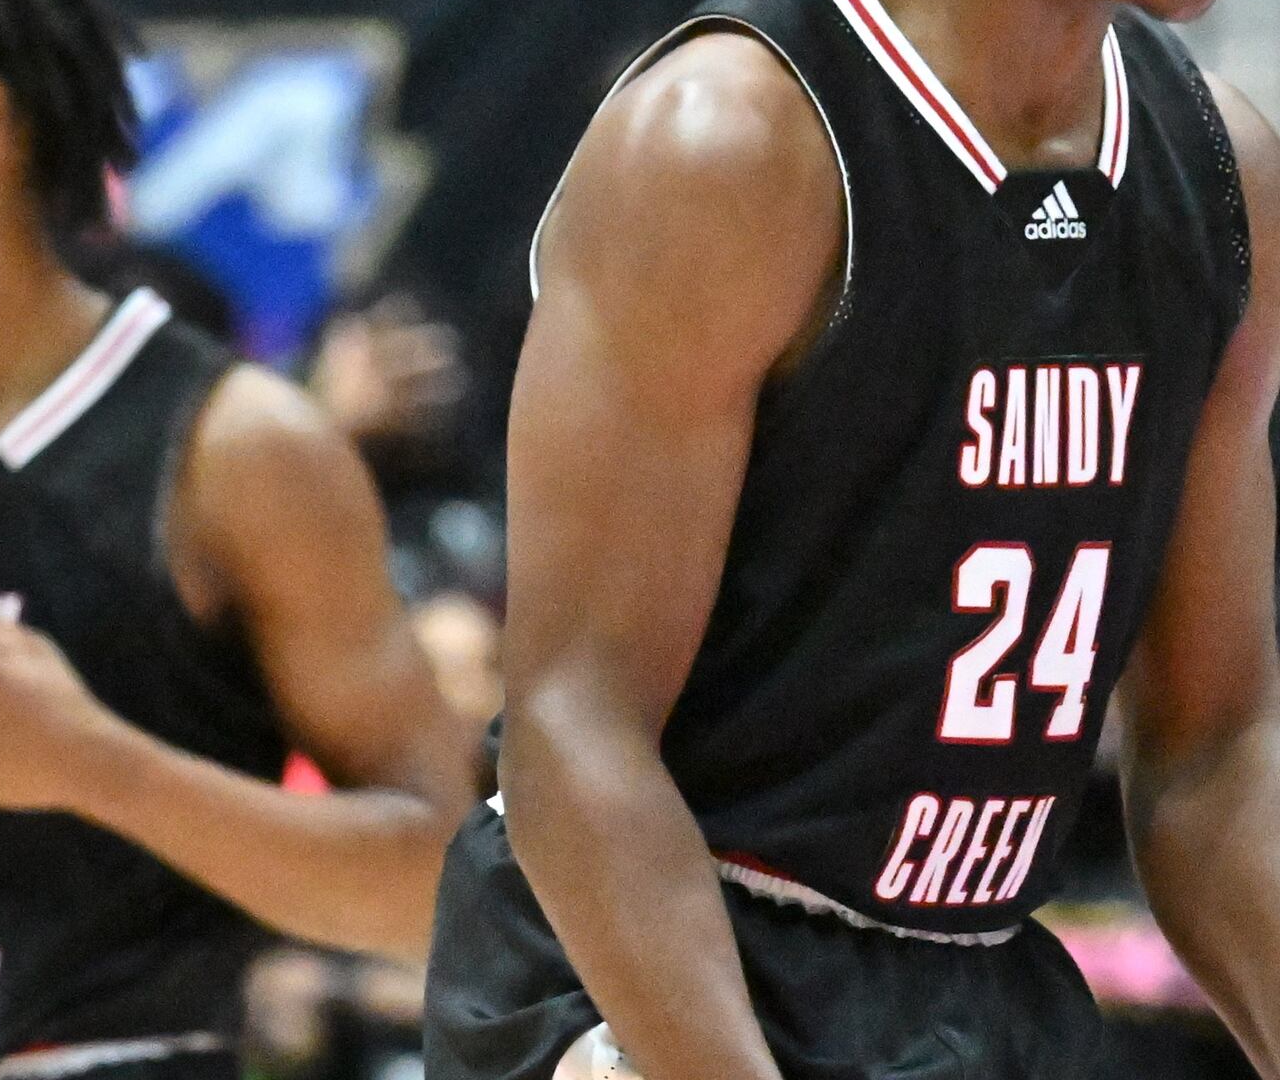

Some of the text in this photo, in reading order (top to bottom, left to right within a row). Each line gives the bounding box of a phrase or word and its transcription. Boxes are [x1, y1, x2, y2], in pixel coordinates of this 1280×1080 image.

[1024, 218, 1087, 240] adidas
[958, 363, 1142, 488] SANDY
[936, 540, 1113, 745] 24
[874, 791, 1057, 906] CREEK
